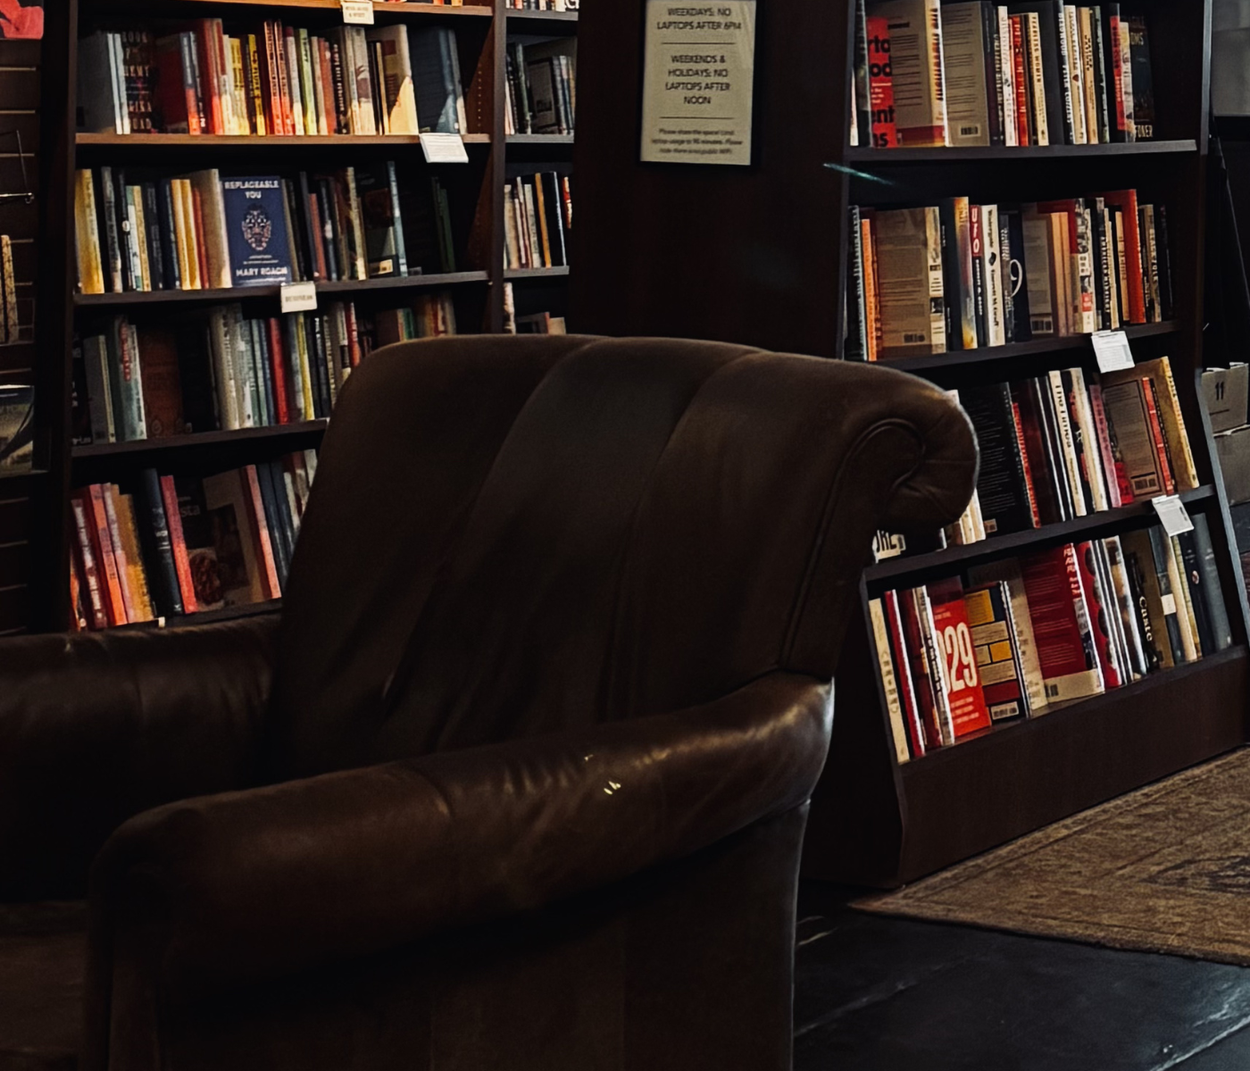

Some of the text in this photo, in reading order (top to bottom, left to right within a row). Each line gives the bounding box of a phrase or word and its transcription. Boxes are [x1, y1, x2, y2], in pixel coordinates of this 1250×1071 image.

[717, 8, 732, 17] NO
[657, 21, 694, 30] LAPTOPS
[695, 21, 723, 30] AFTER
[671, 54, 726, 64] WEEKENDS &
[713, 69, 728, 78] NO
[665, 82, 730, 91] LAPTOPS AFTER
[683, 96, 711, 105] NOON
[224, 179, 279, 190] REPLACEABLE
[244, 190, 262, 200] YOU
[970, 209, 980, 253] UFO
[236, 266, 288, 277] MARY ROACH
[1138, 595, 1154, 643] Caste
